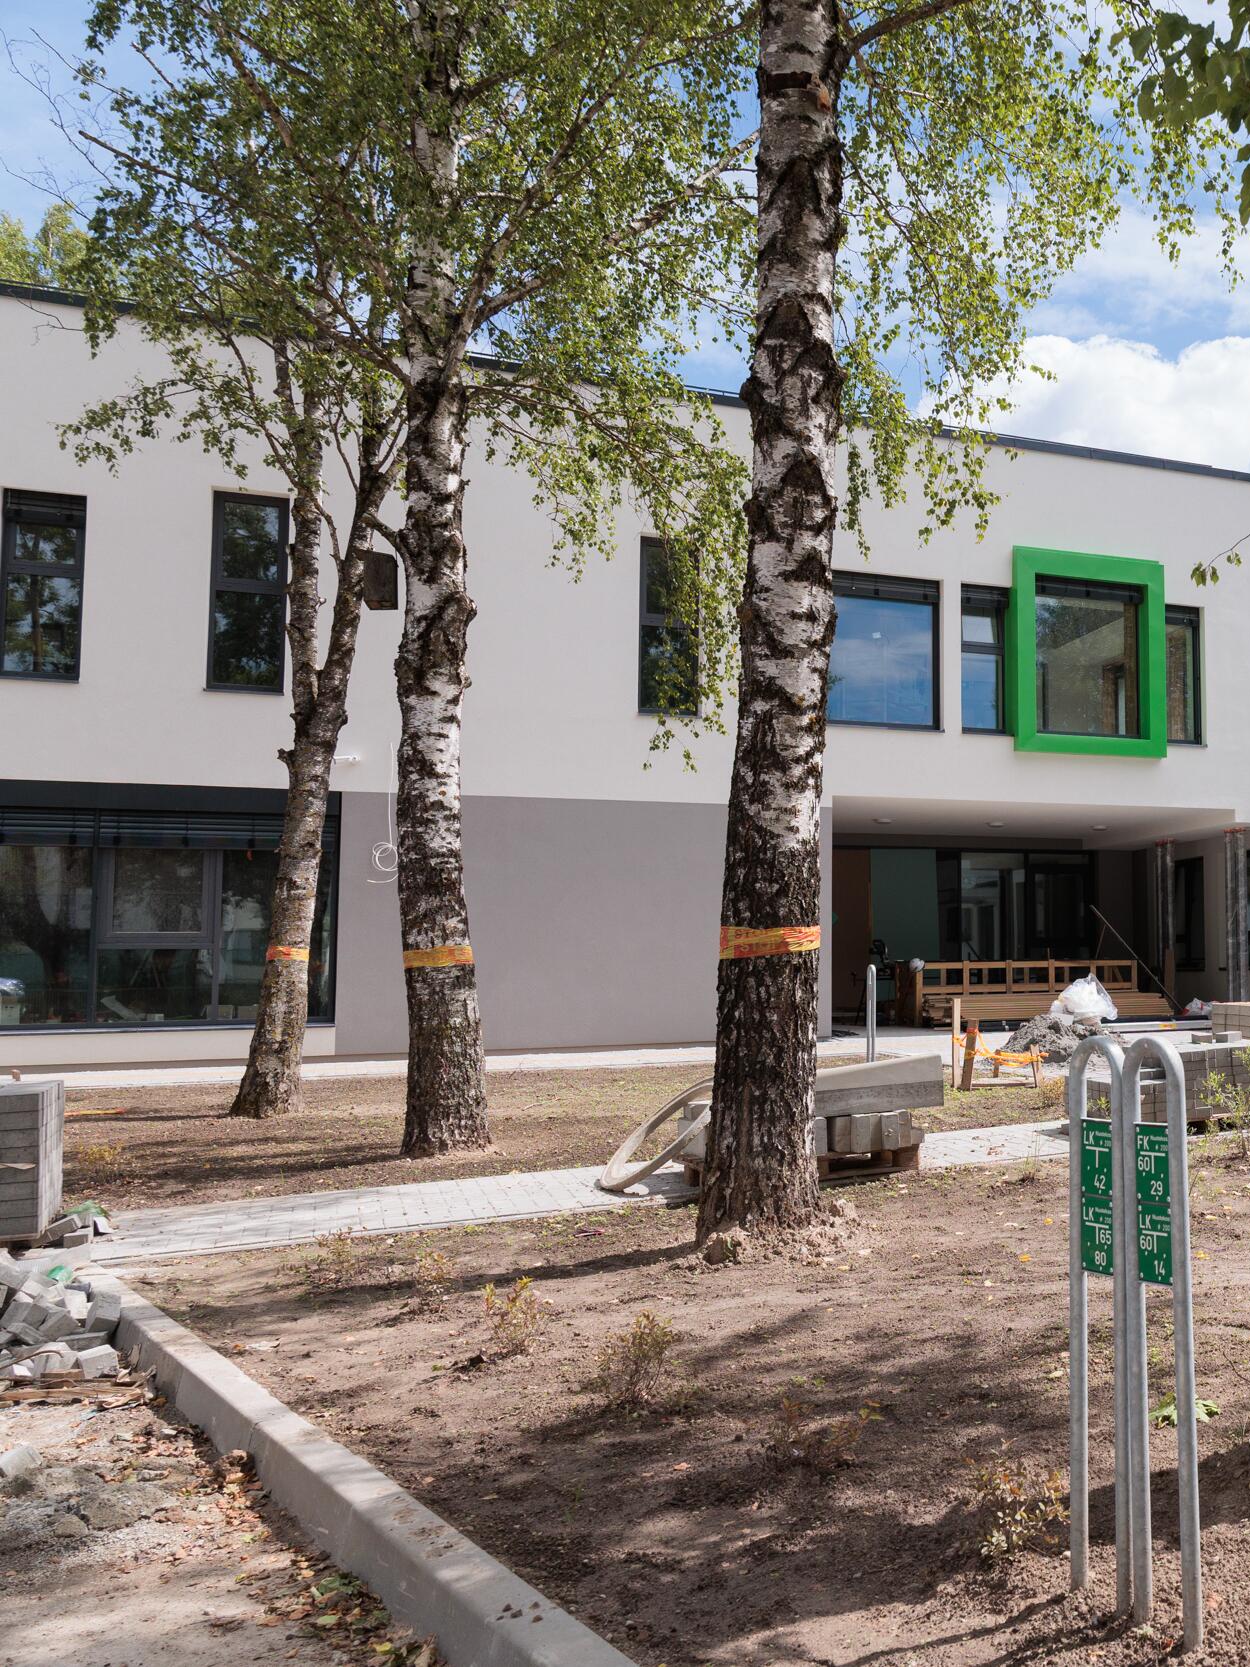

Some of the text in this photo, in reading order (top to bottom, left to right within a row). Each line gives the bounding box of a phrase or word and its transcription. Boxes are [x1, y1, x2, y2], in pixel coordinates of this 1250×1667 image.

[1083, 1130, 1095, 1145] LK
[1137, 1135, 1150, 1151] FK
[1138, 1156, 1150, 1171] 60
[1094, 1174, 1106, 1190] 42
[1150, 1180, 1163, 1196] 29
[1083, 1206, 1095, 1221] LK
[1139, 1213, 1152, 1229] LK
[1100, 1229, 1112, 1245] 65
[1139, 1235, 1153, 1251] 60
[1094, 1250, 1107, 1266] 80
[1154, 1260, 1166, 1276] 14
